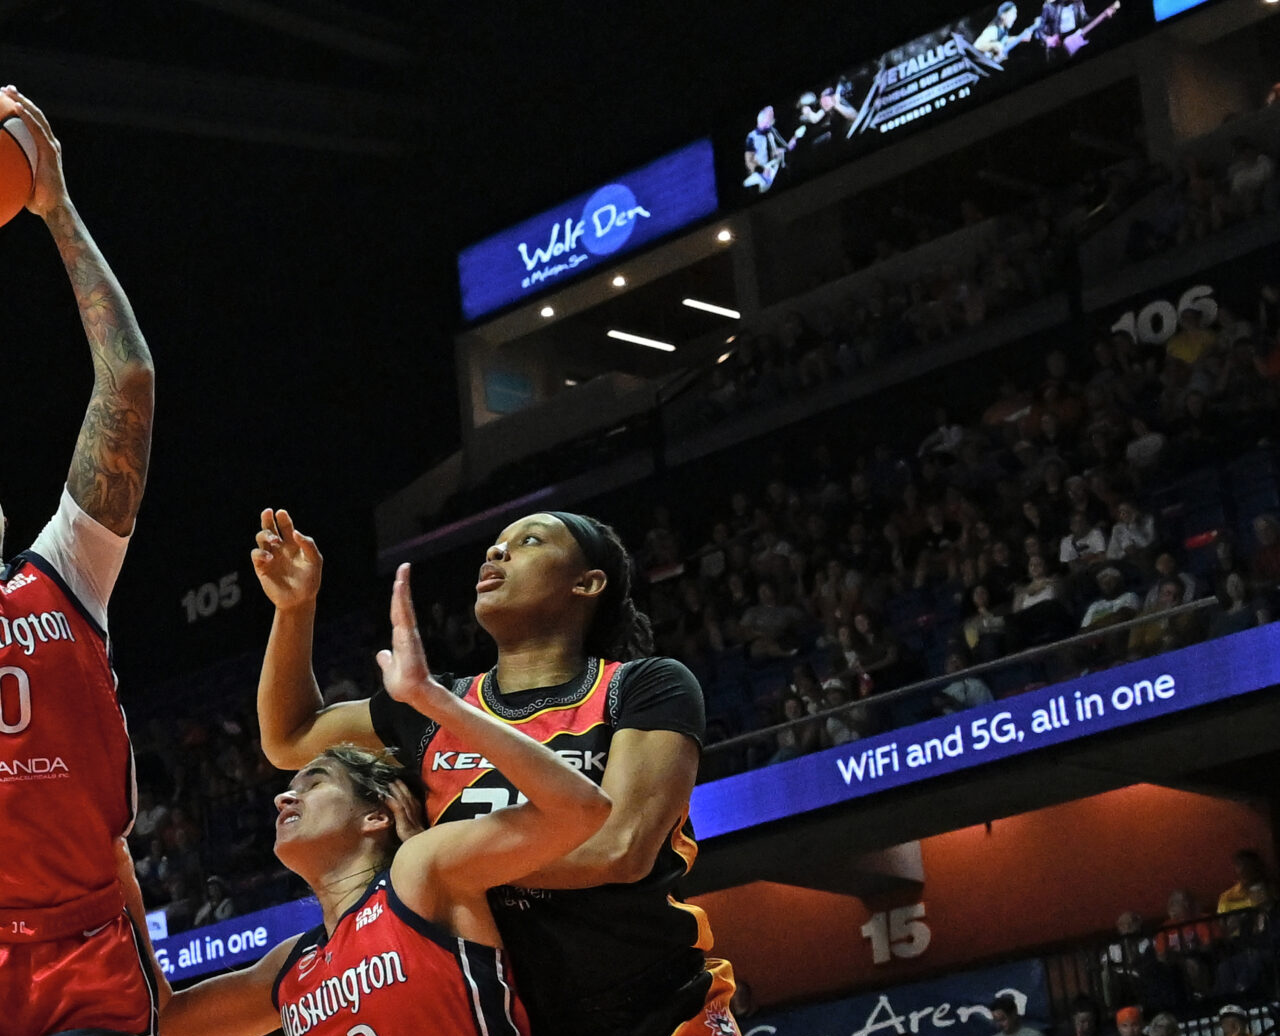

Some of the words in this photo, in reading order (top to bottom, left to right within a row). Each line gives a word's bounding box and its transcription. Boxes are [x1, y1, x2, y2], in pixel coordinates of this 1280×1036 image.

[518, 217, 585, 271] Wolf
[593, 204, 651, 238] Den
[181, 571, 242, 623] 105
[836, 742, 900, 785] WiFi
[906, 725, 964, 768] and
[971, 711, 1025, 750] 5G,
[1031, 695, 1070, 733] all
[1074, 691, 1104, 722] in
[1111, 674, 1175, 710] one
[178, 938, 203, 968] all
[205, 936, 225, 960] in
[227, 926, 268, 954] one
[861, 902, 932, 965] 15
